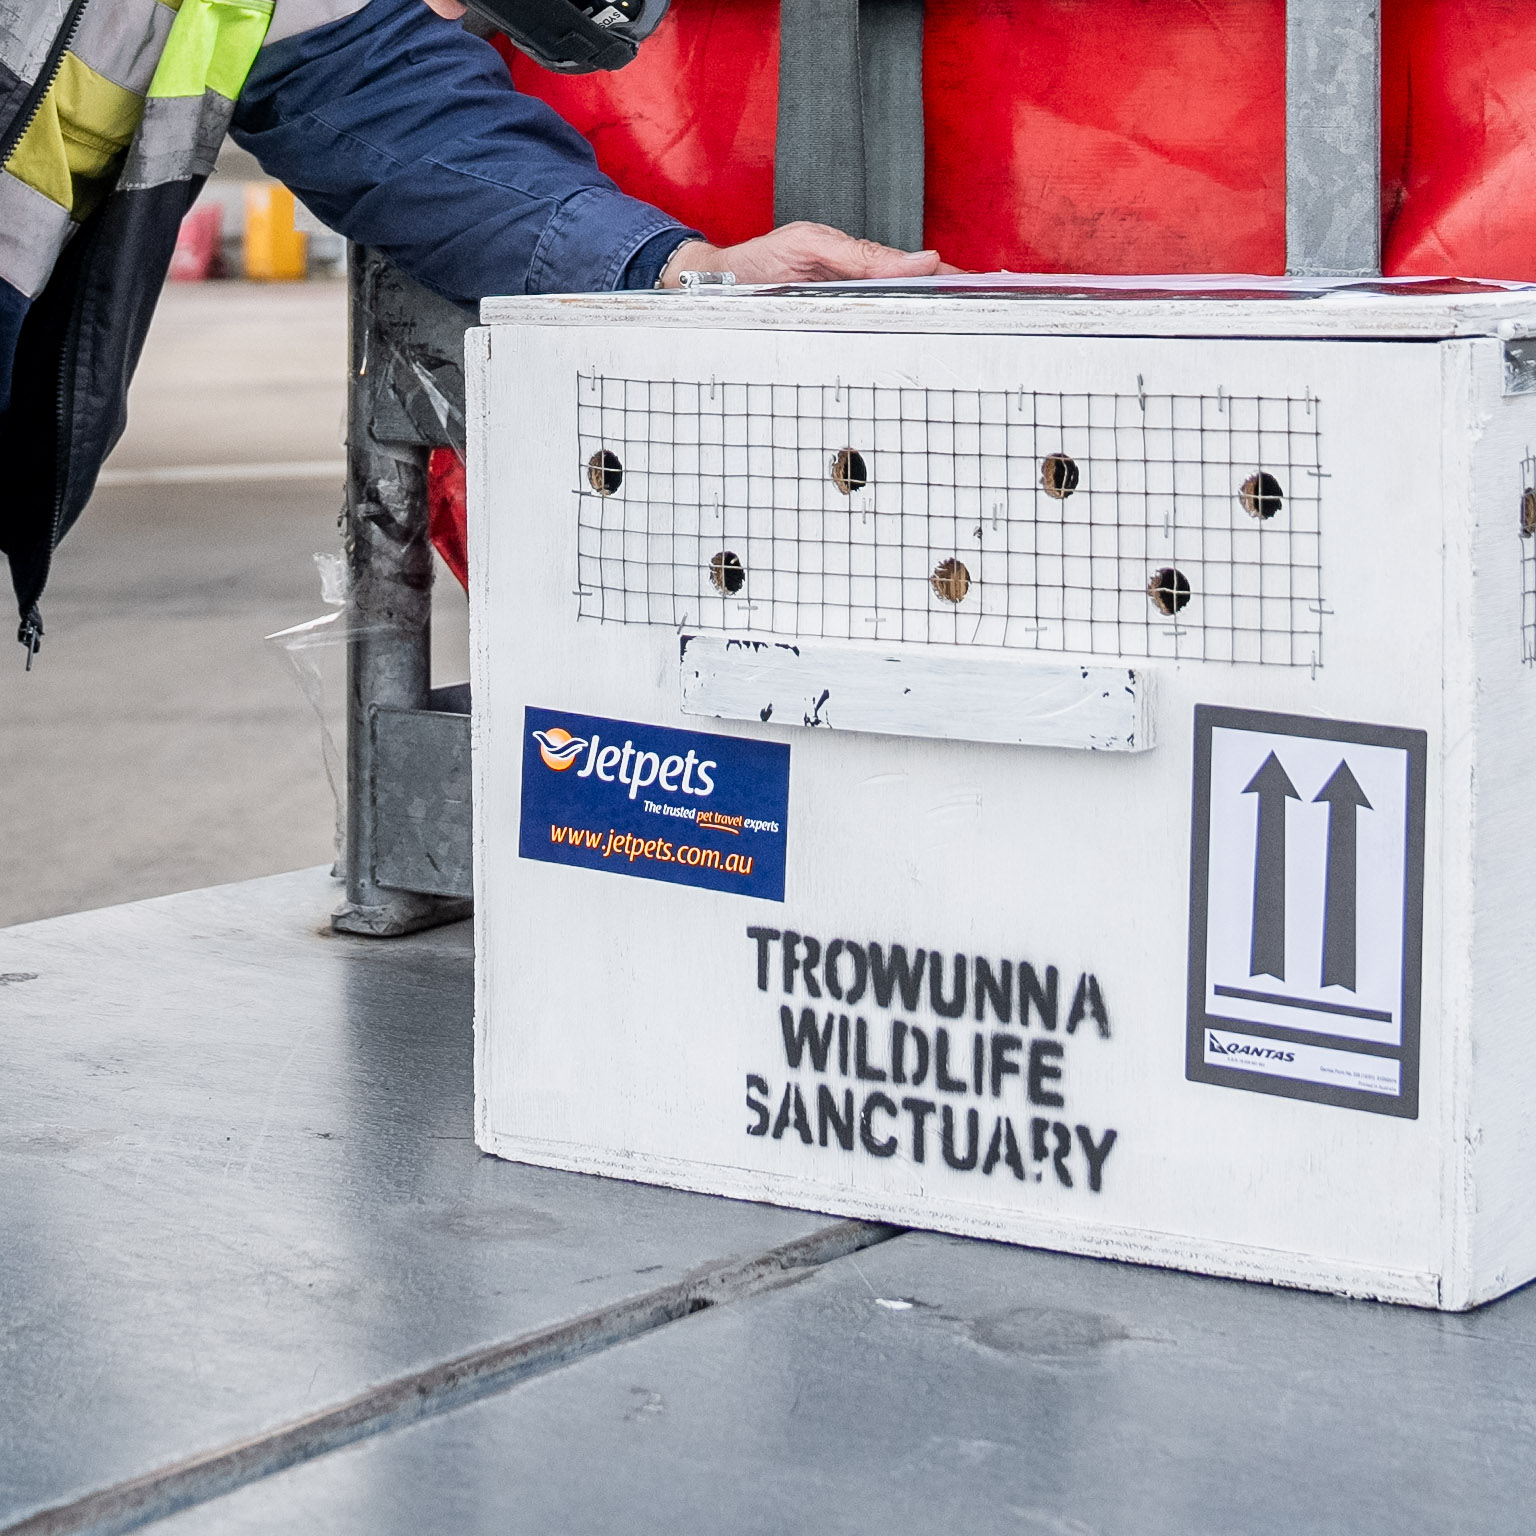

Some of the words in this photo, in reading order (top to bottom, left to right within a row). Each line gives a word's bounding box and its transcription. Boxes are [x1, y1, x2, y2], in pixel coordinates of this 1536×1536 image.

[577, 734, 717, 800] Jetpets
[550, 824, 754, 875] www.jetpets.com.au
[644, 800, 662, 814] The
[663, 804, 696, 819] trusted
[696, 811, 714, 823] pet
[714, 812, 743, 827] travel
[744, 818, 780, 833] experts
[746, 926, 1112, 1040] TROWUNNA
[780, 1004, 1065, 1108] WILDLIFE
[1226, 1042, 1296, 1063] QANTAS
[746, 1073, 1118, 1193] SANCTUARY
